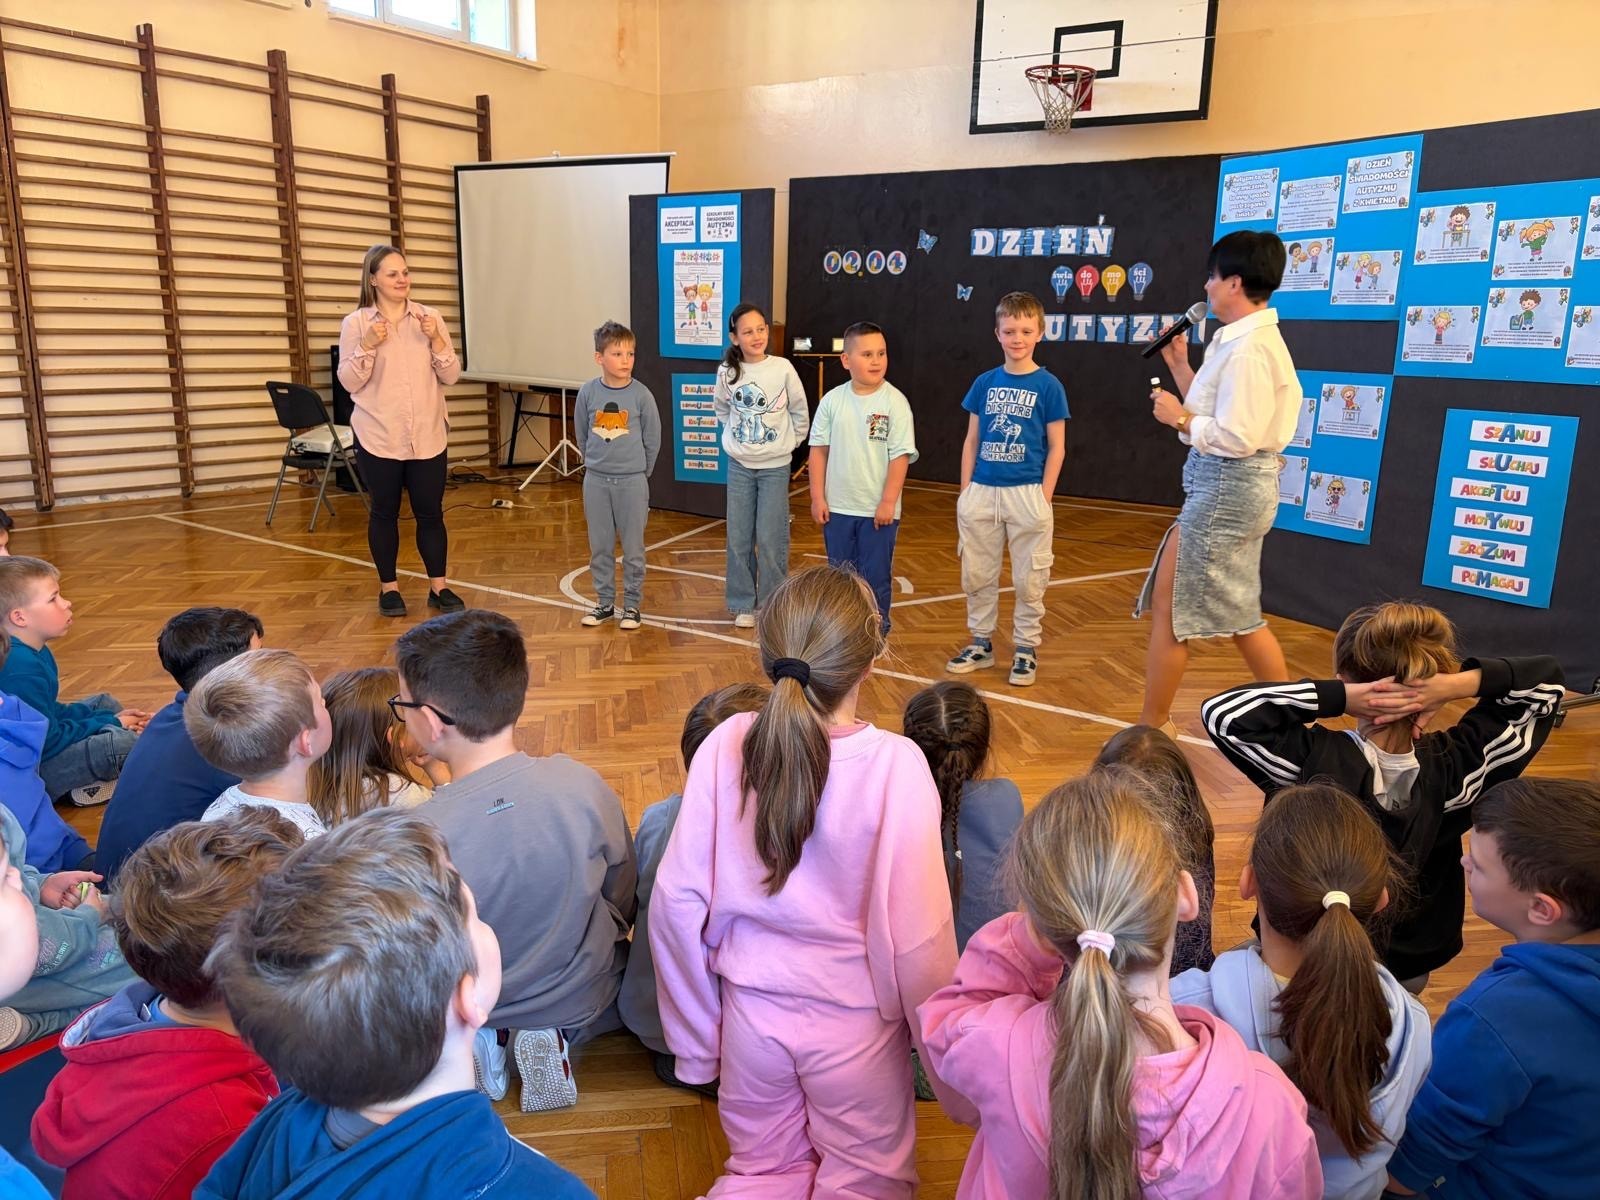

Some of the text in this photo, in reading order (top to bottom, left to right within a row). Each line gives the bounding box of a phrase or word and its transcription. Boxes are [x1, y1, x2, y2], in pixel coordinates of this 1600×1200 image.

[1366, 156, 1392, 169] DZIEŃ
[1355, 184, 1397, 195] AUTYZMU
[1359, 196, 1397, 206] KWIETNIA
[973, 214, 1112, 255] DZIEŃ
[987, 388, 1037, 407] DON'T
[985, 403, 1032, 418] DISTURB
[1484, 424, 1542, 443] SZANUJ
[1480, 453, 1540, 475] SŁUCHAJ
[1460, 484, 1521, 502] AKCEPTUJ
[1464, 512, 1525, 532] MOTYWUJ
[1458, 540, 1516, 562] ZROZUM
[1461, 570, 1524, 592] POMAGAJ
